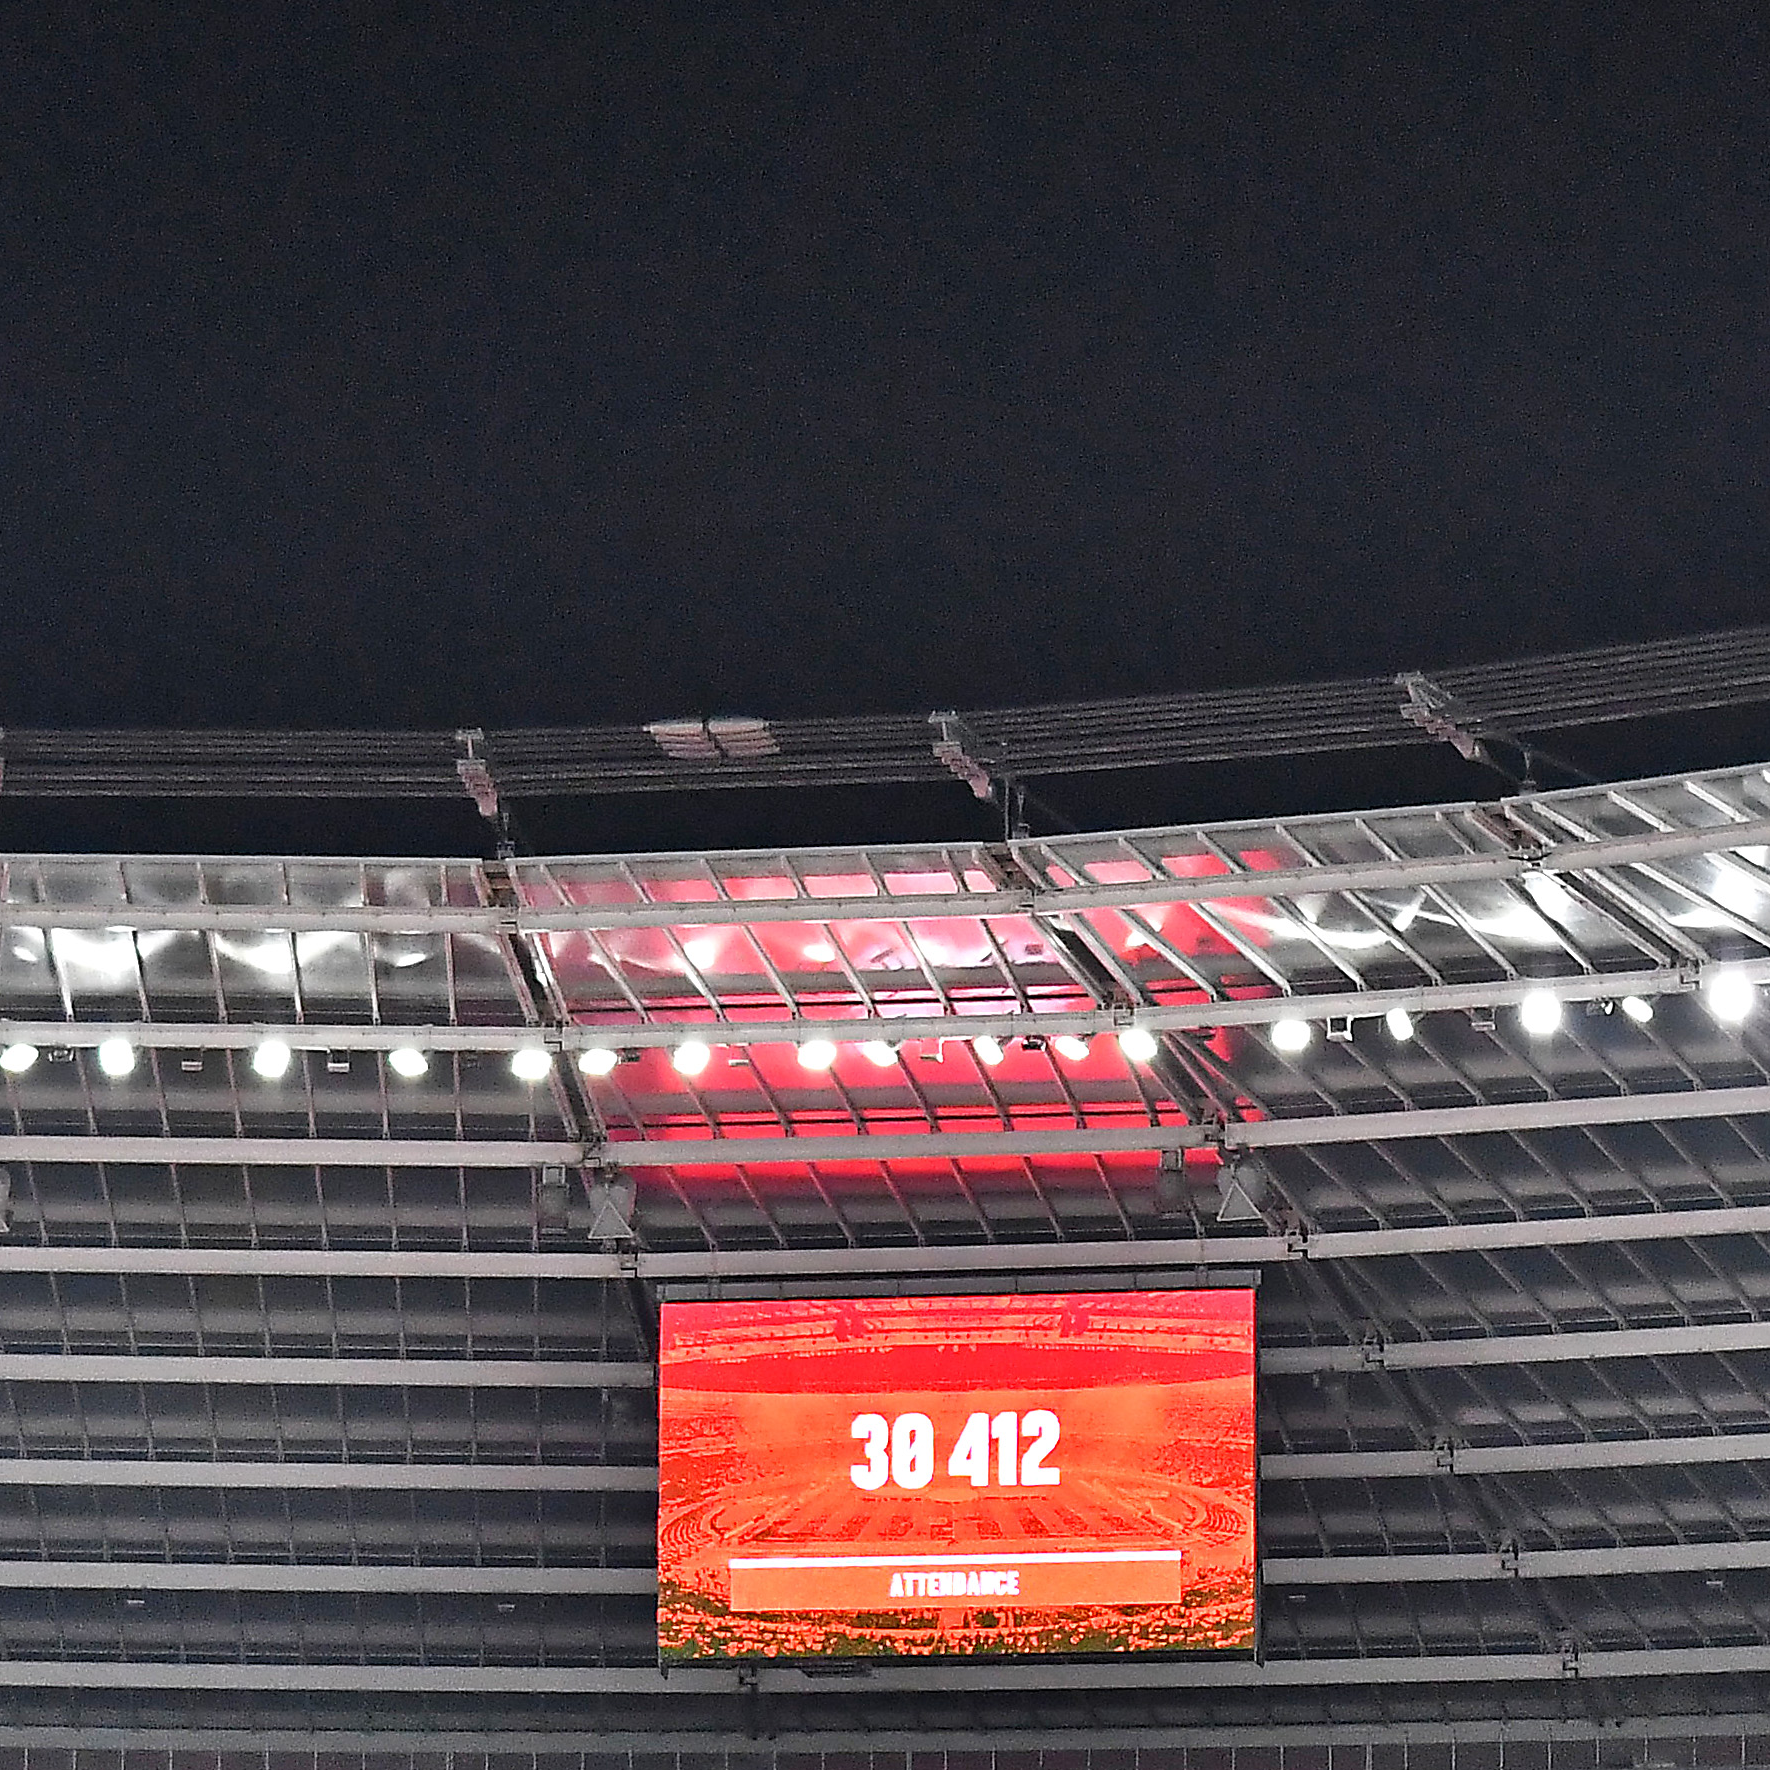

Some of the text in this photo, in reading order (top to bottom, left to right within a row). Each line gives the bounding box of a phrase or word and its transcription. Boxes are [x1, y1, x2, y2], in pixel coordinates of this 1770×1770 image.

[850, 1410, 1061, 1490] 30 412
[889, 1571, 1020, 1598] ATTENDANCE
